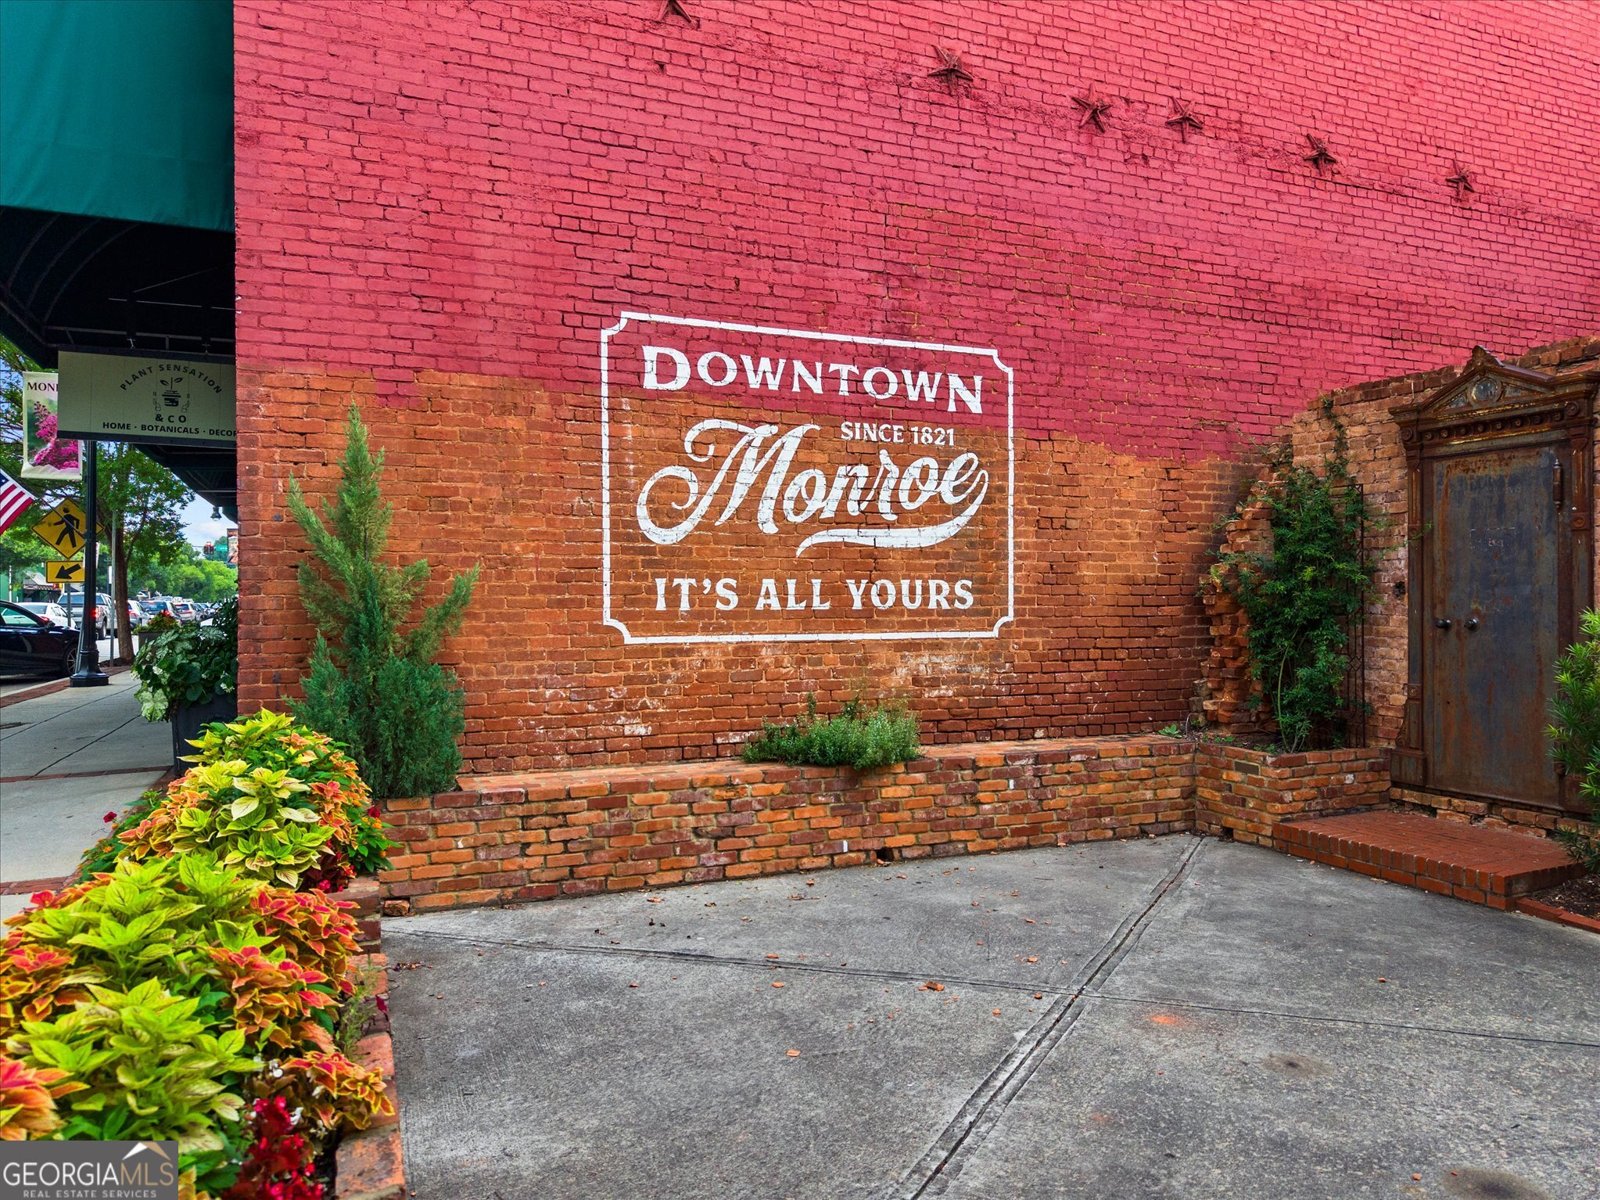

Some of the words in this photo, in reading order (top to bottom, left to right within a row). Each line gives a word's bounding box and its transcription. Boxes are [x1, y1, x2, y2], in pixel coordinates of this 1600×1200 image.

[120, 366, 153, 390] PLANT
[159, 364, 222, 394] SENSATION
[642, 345, 983, 413] DOWNTOWN
[103, 422, 131, 430] HOME
[141, 424, 199, 434] BOTANICALS
[155, 414, 163, 422] &
[840, 422, 904, 444] SINCE
[911, 426, 955, 446] 1821
[636, 419, 989, 557] Monroe
[655, 577, 739, 611] IT'S
[755, 578, 831, 611] ALL
[846, 578, 974, 610] YOURS
